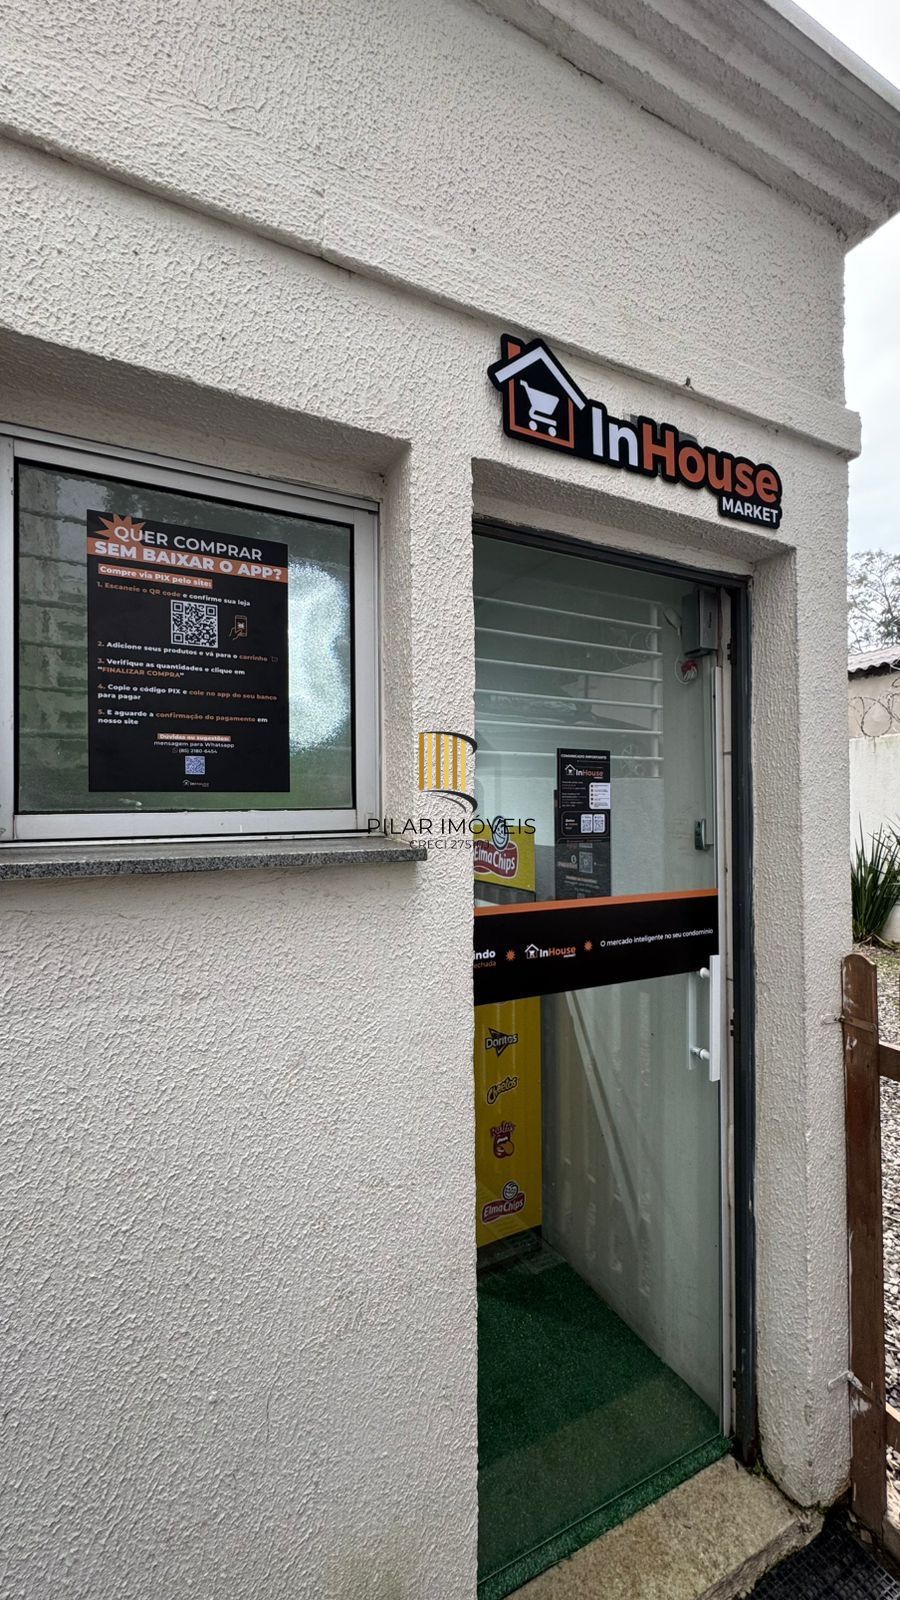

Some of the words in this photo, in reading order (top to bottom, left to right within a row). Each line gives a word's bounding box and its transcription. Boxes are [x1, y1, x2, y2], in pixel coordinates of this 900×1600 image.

[591, 406, 779, 503] InHouse
[722, 496, 779, 523] MARKET
[114, 526, 168, 546] QUER
[173, 536, 262, 561] COMPRAR
[94, 541, 137, 559] SEM
[142, 548, 214, 571] BAIXAR
[219, 561, 233, 573] O
[237, 566, 282, 581] APP?
[99, 566, 137, 577] Compre
[139, 570, 153, 579] via
[155, 573, 170, 582] PIX
[172, 576, 192, 585] pelo
[193, 579, 212, 587] site:
[104, 582, 140, 592] Escaneie
[188, 593, 222, 603] confirme
[106, 642, 142, 650] Adicione
[163, 647, 197, 655] produtos
[106, 658, 144, 667] Verifique
[156, 663, 203, 672] quantidades
[211, 667, 232, 675] clique
[117, 693, 141, 701] pagar
[140, 686, 166, 694] código
[156, 711, 203, 720] confirmação
[576, 769, 604, 777] InHouse
[606, 936, 633, 947] mercado
[634, 934, 664, 943] inteligente
[540, 946, 577, 958] InHouse
[486, 1034, 519, 1049] Doritos
[487, 1077, 518, 1105] Cheetos
